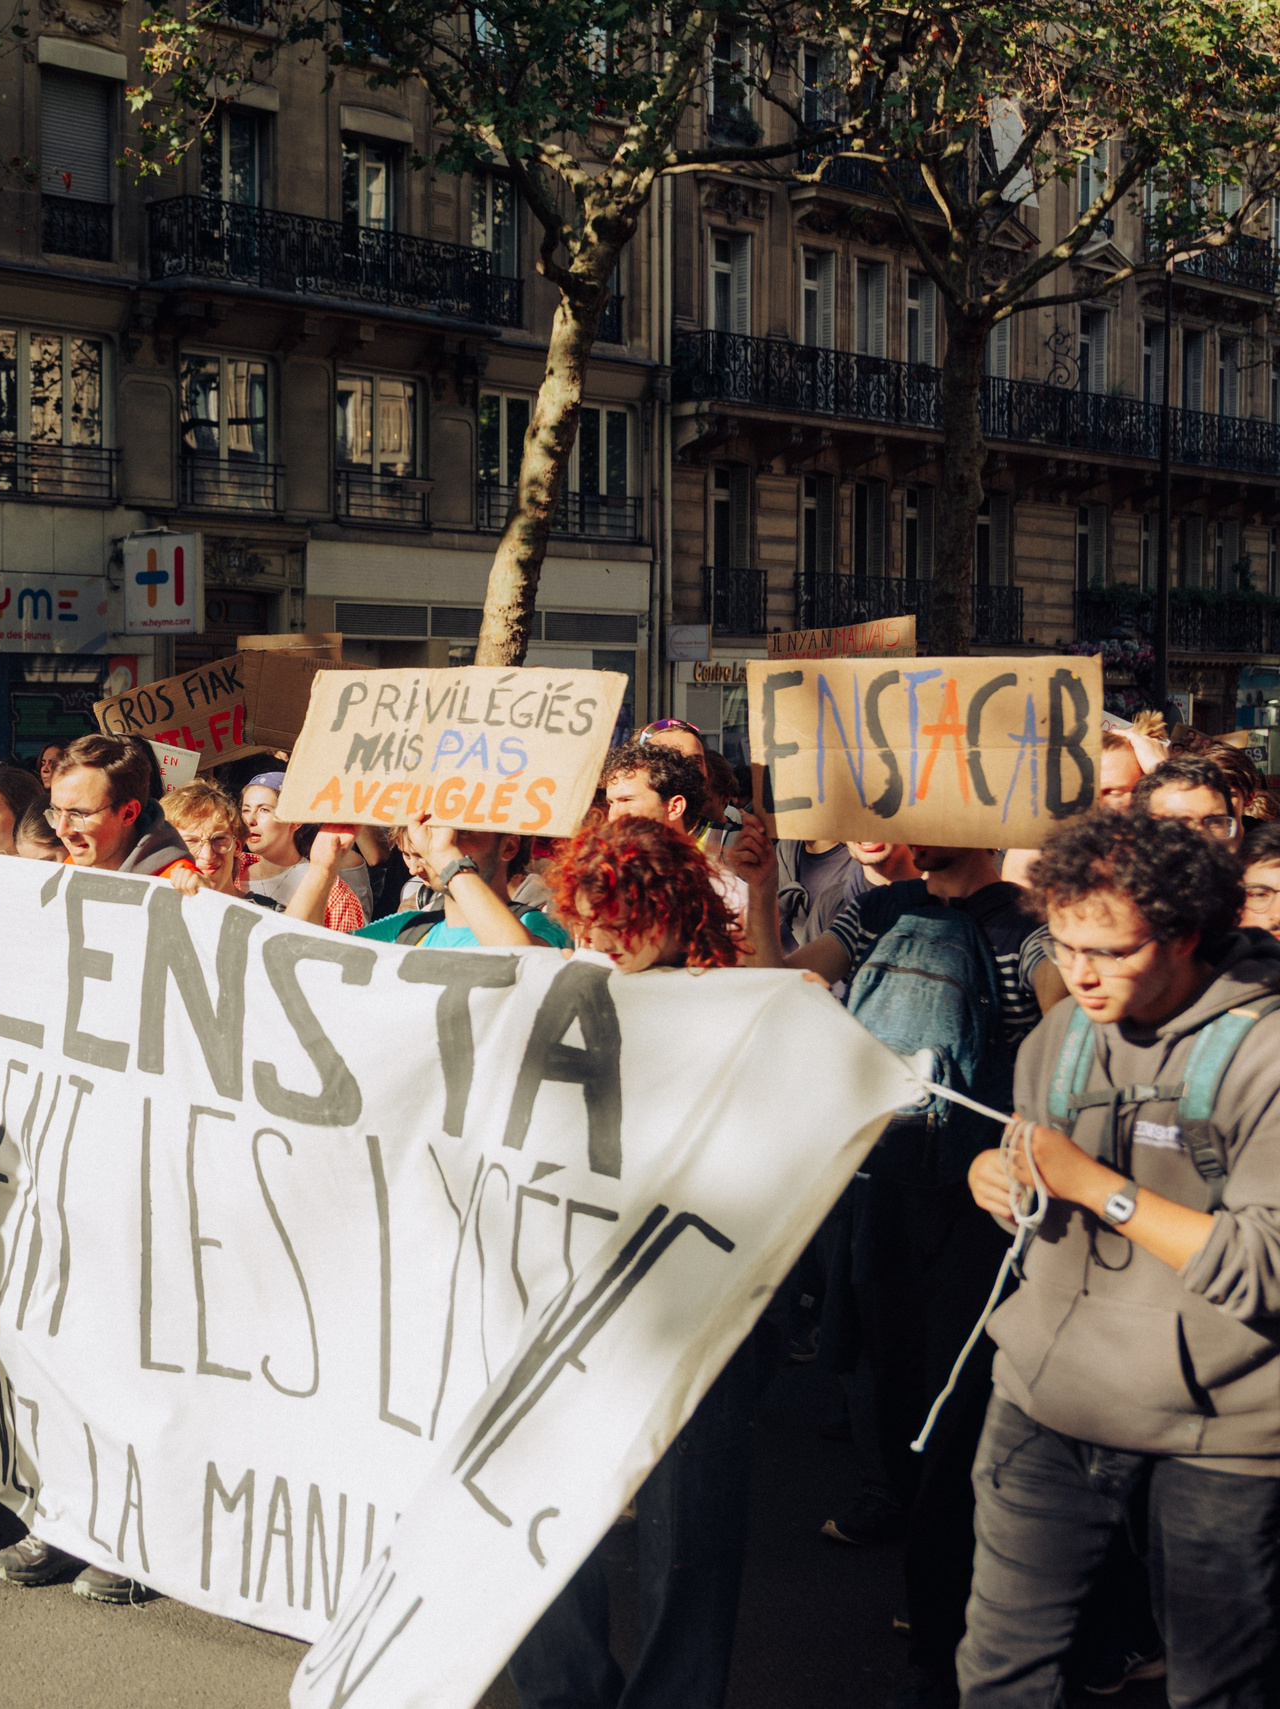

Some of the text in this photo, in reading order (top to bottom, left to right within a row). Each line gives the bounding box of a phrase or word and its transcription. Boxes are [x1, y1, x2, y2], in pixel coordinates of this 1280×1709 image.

[834, 620, 902, 656] MAUVAIS
[102, 684, 175, 735] GROS
[181, 664, 245, 709] FIAK
[693, 660, 731, 682] Centre
[430, 728, 529, 777] PAS
[138, 1096, 322, 1399] LES
[82, 1421, 153, 1574] LA
